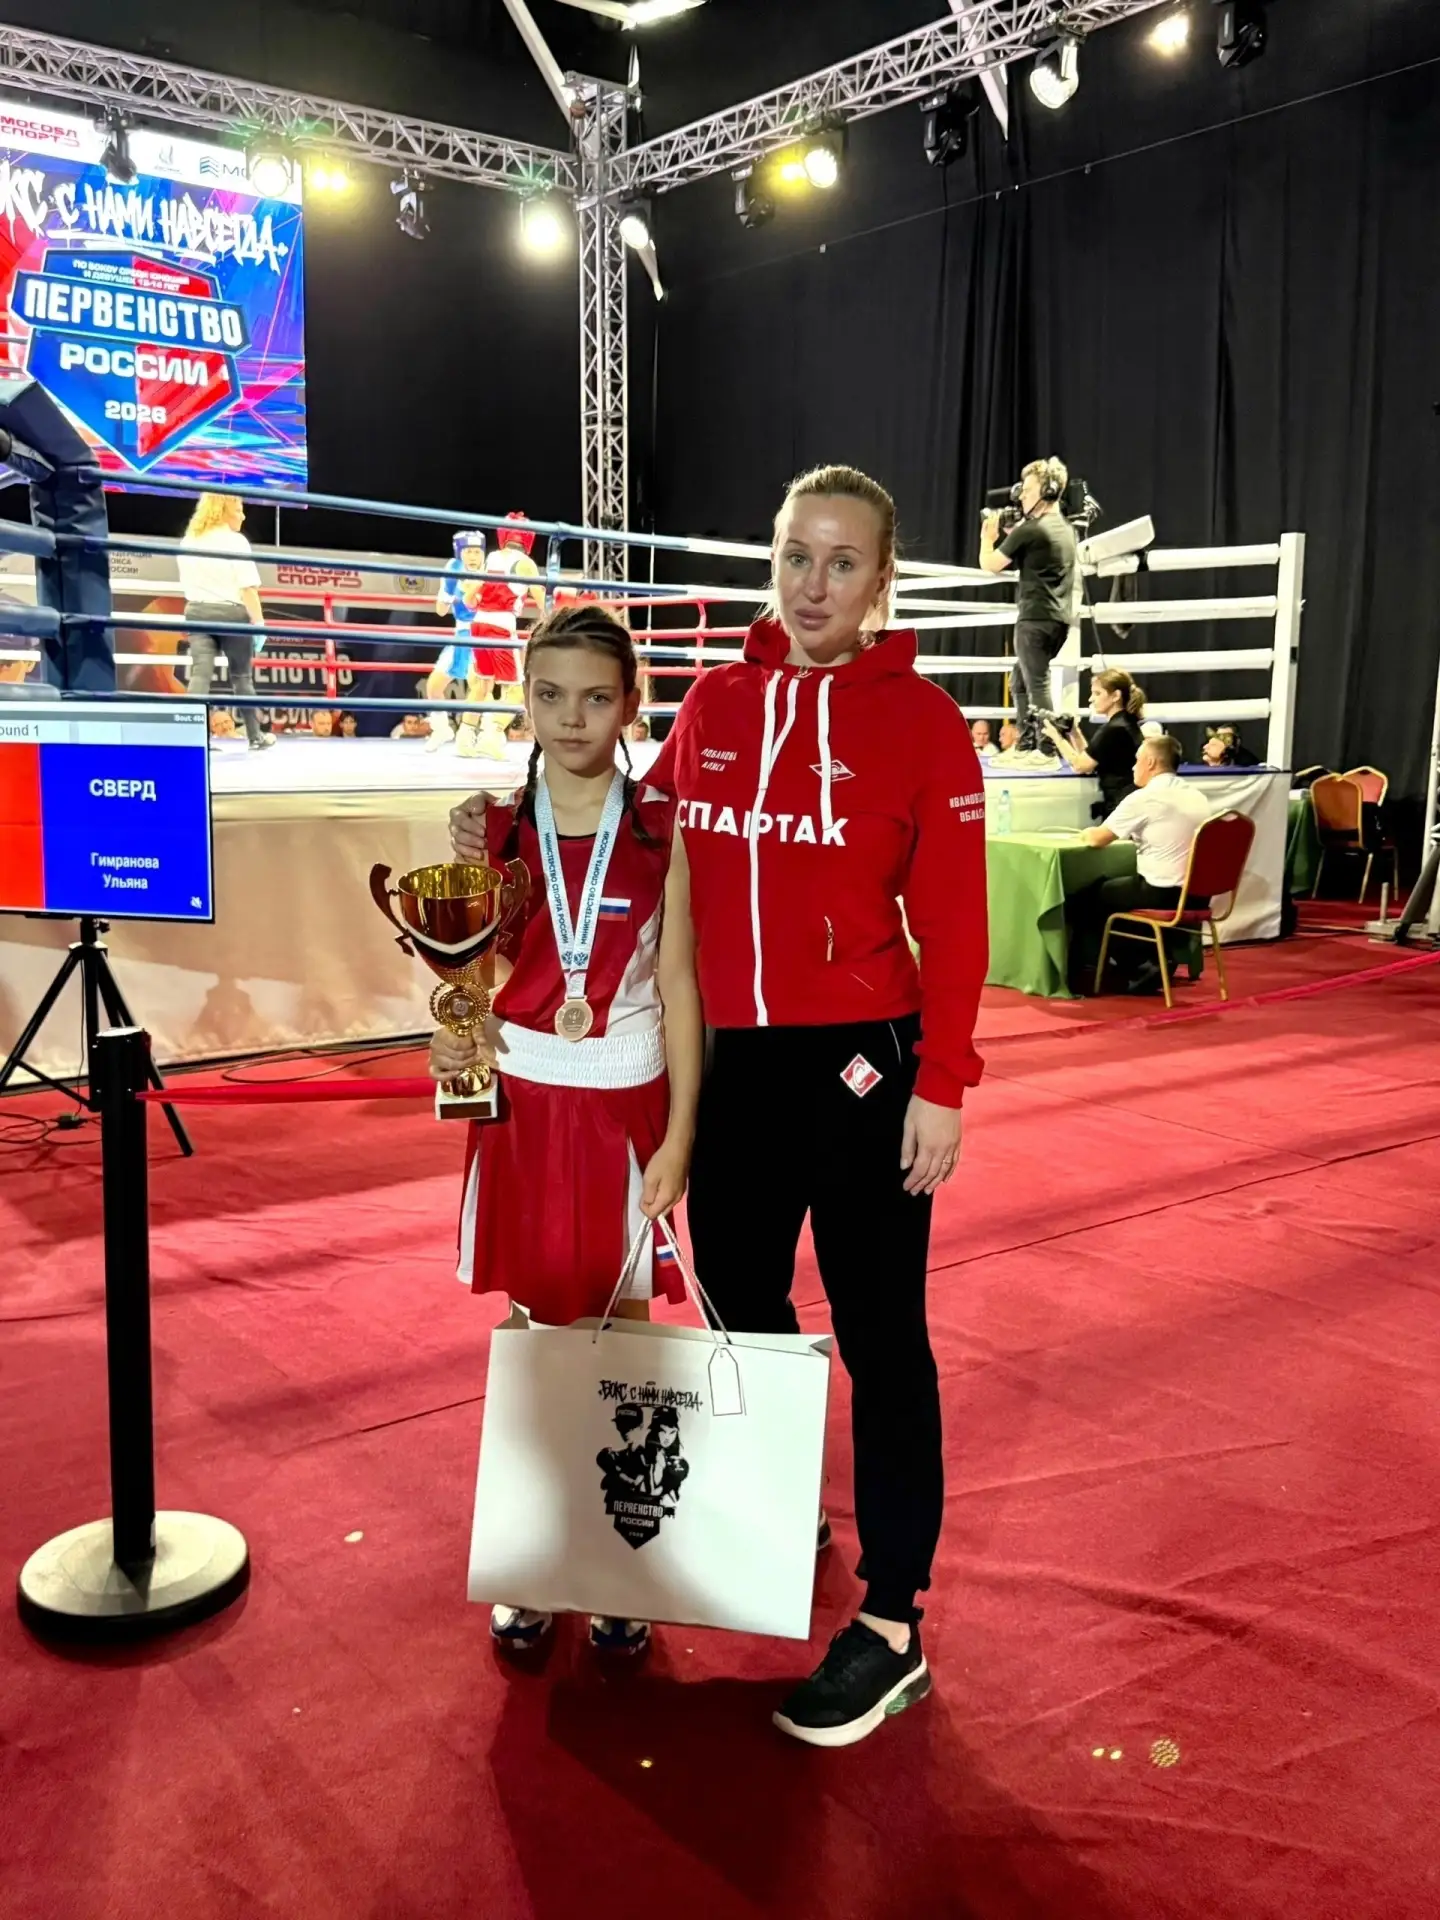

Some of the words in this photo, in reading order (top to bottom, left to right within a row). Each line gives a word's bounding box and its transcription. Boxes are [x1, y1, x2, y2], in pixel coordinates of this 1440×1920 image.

[0, 115, 77, 139] МОСОБЛ
[1, 125, 60, 144] СПОРТ
[0, 160, 48, 240] КС
[83, 182, 154, 240] НАМИ
[24, 279, 243, 347] ПЕРВЕНСТВО
[60, 342, 208, 387] РОССИИ
[104, 401, 167, 424] 2026
[277, 573, 341, 587] СПОРТ
[0, 724, 29, 737] ound
[34, 725, 40, 737] 1
[89, 779, 156, 801] СВЕРД
[677, 799, 849, 846] СПАРТАК
[90, 852, 160, 871] Гимранова
[103, 874, 148, 889] Ульяна
[581, 888, 596, 944] МИНИСТЕРСТВО
[592, 859, 603, 885] СПОРТА
[598, 831, 610, 857] РОССИИ
[552, 883, 563, 912] СПОРТА
[559, 912, 569, 944] РОССИИ
[613, 1500, 664, 1518] ПЕРВЕНСТВО
[620, 1516, 655, 1528] РОССИИ
